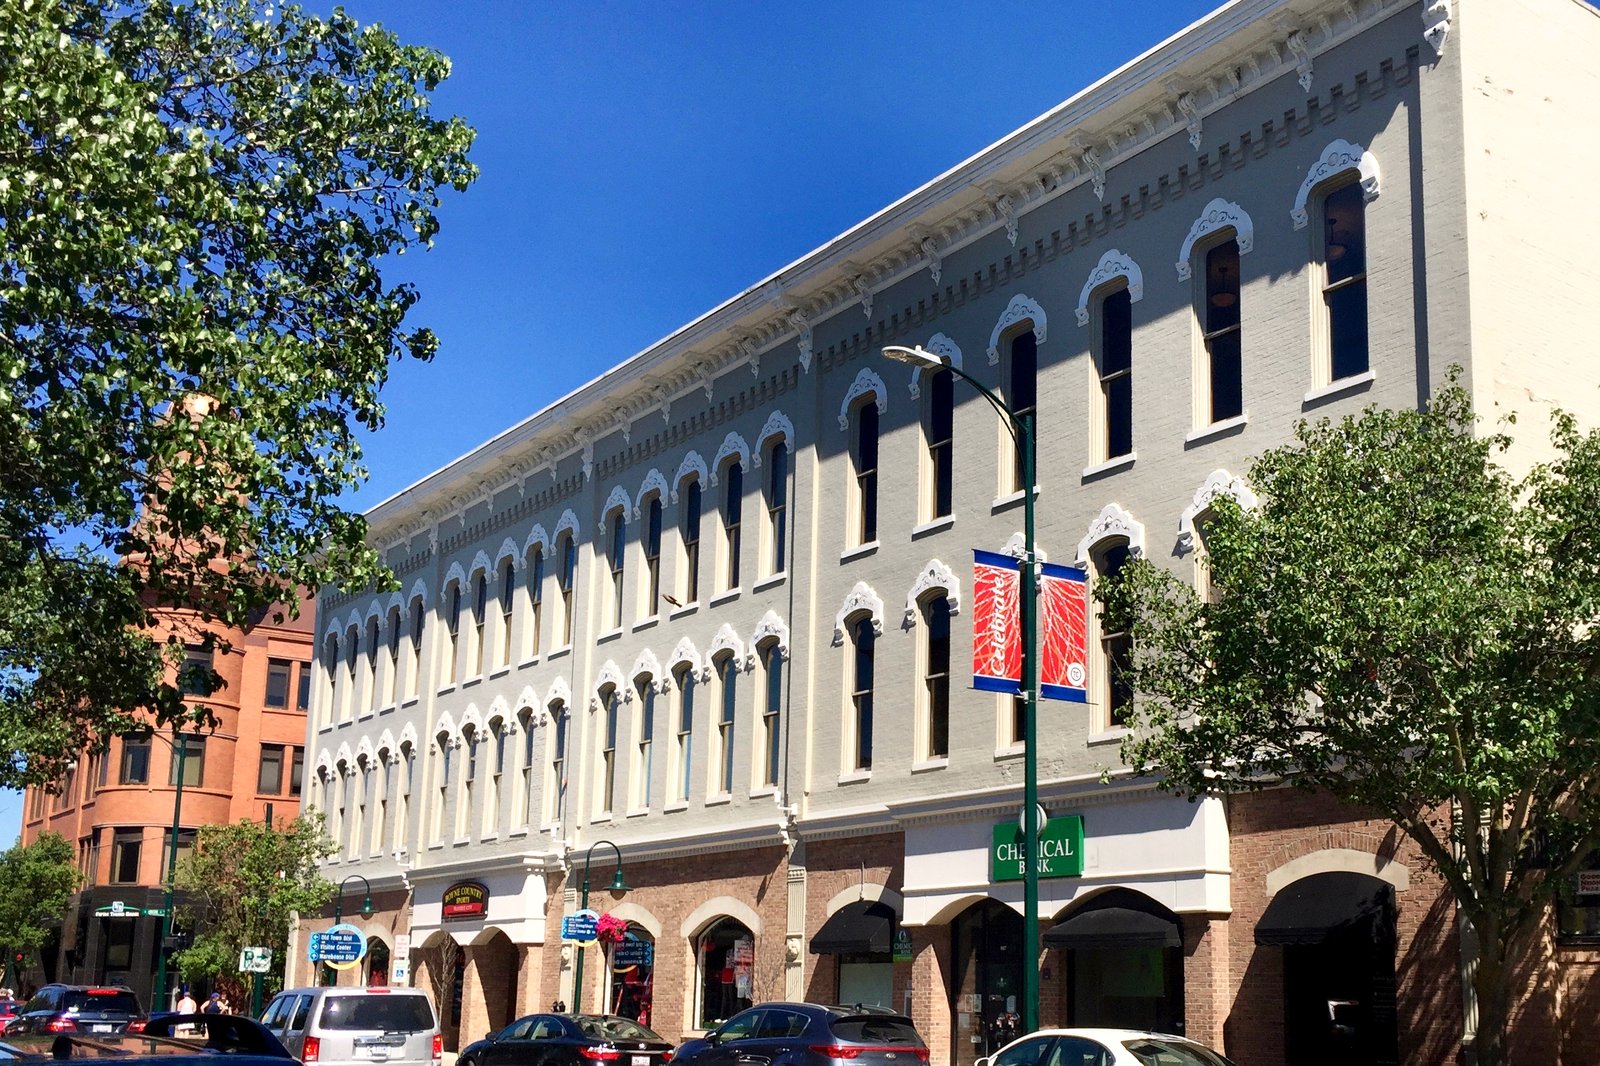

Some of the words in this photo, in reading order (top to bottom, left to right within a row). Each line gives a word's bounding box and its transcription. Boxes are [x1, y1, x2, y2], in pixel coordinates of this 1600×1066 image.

[990, 569, 1005, 676] Celebrate!
[997, 839, 1073, 861] CHEICAL
[1018, 859, 1050, 874] BNK
